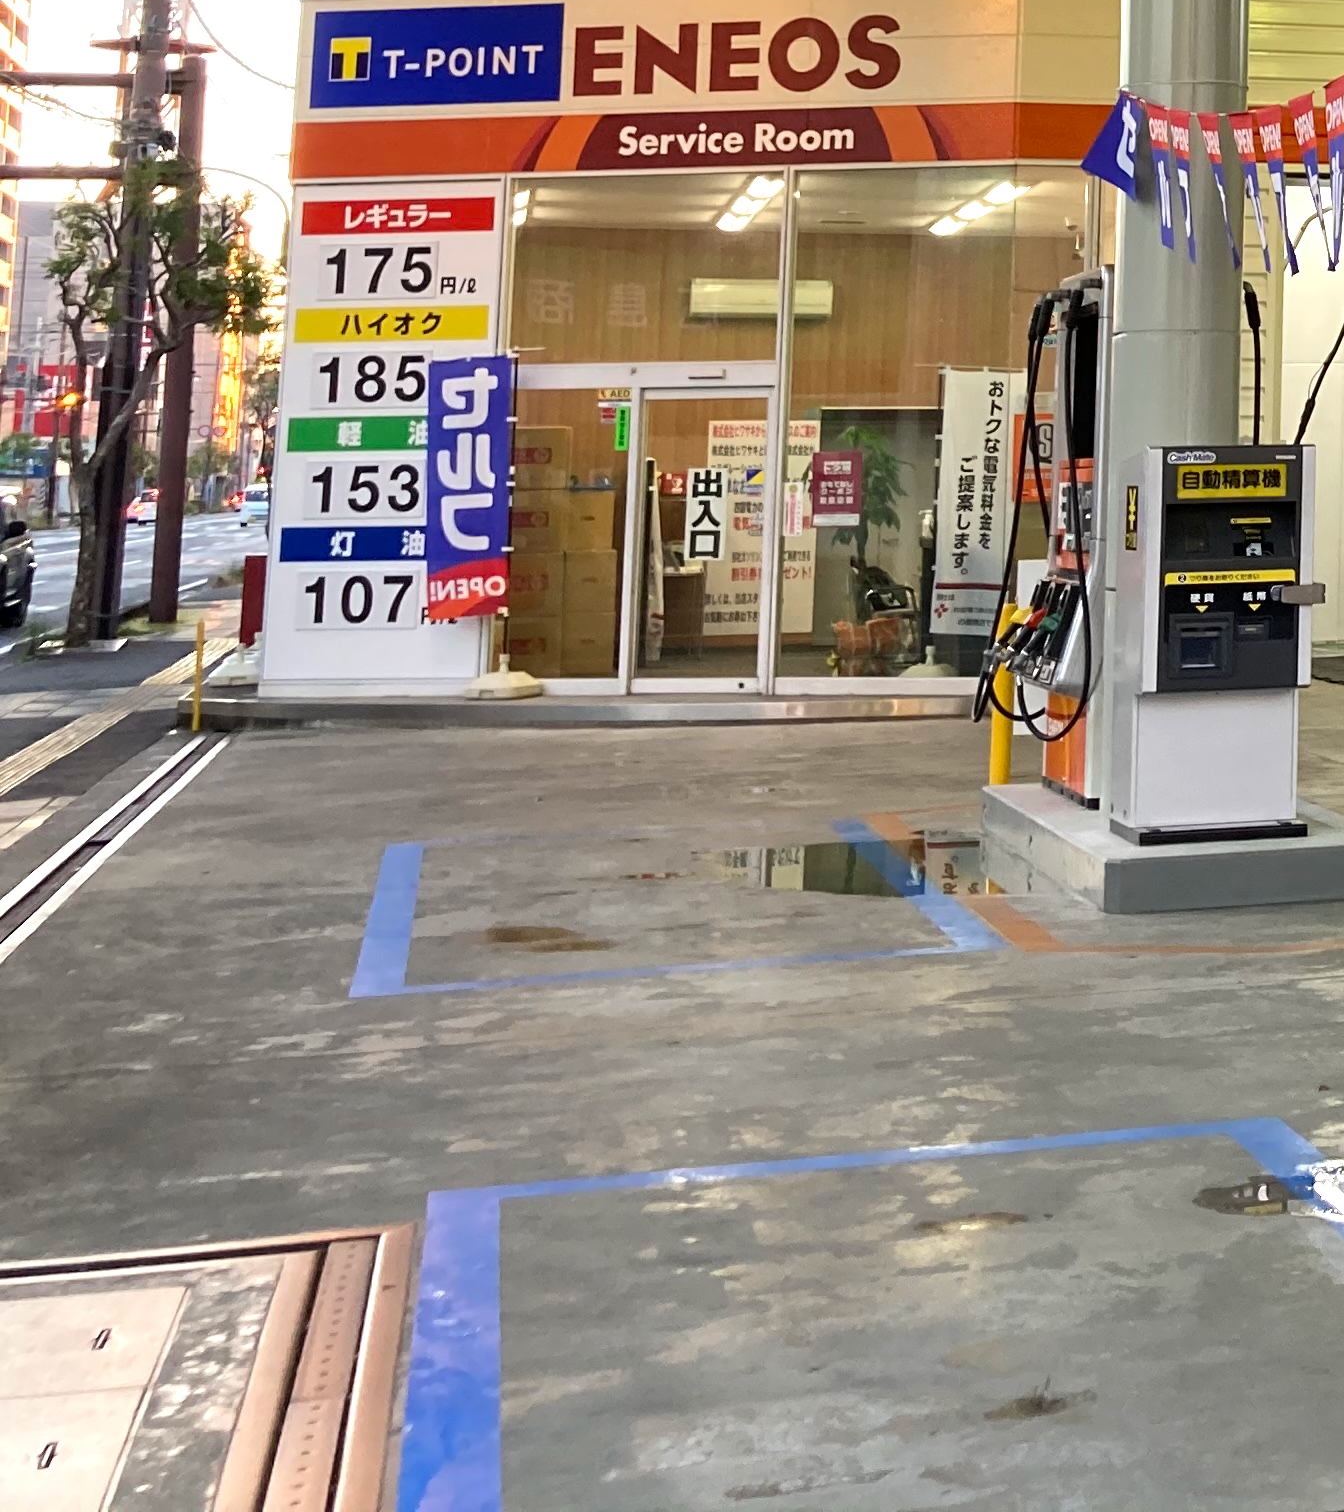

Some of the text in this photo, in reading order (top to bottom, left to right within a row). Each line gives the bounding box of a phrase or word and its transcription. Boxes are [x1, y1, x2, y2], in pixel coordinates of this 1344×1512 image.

[383, 45, 543, 79] T-POINT
[573, 14, 901, 96] ENEOS
[618, 123, 854, 156] Service Room
[344, 204, 452, 229] レギュラー
[326, 246, 433, 294] 175
[341, 312, 442, 336] ハイオク
[319, 355, 426, 403] 185
[312, 464, 420, 513] 153
[1182, 469, 1281, 490] 自動精算機
[689, 470, 722, 558] 出入口
[952, 455, 978, 575] ご提案します。
[330, 530, 426, 557] 灯油
[305, 575, 413, 624] 107
